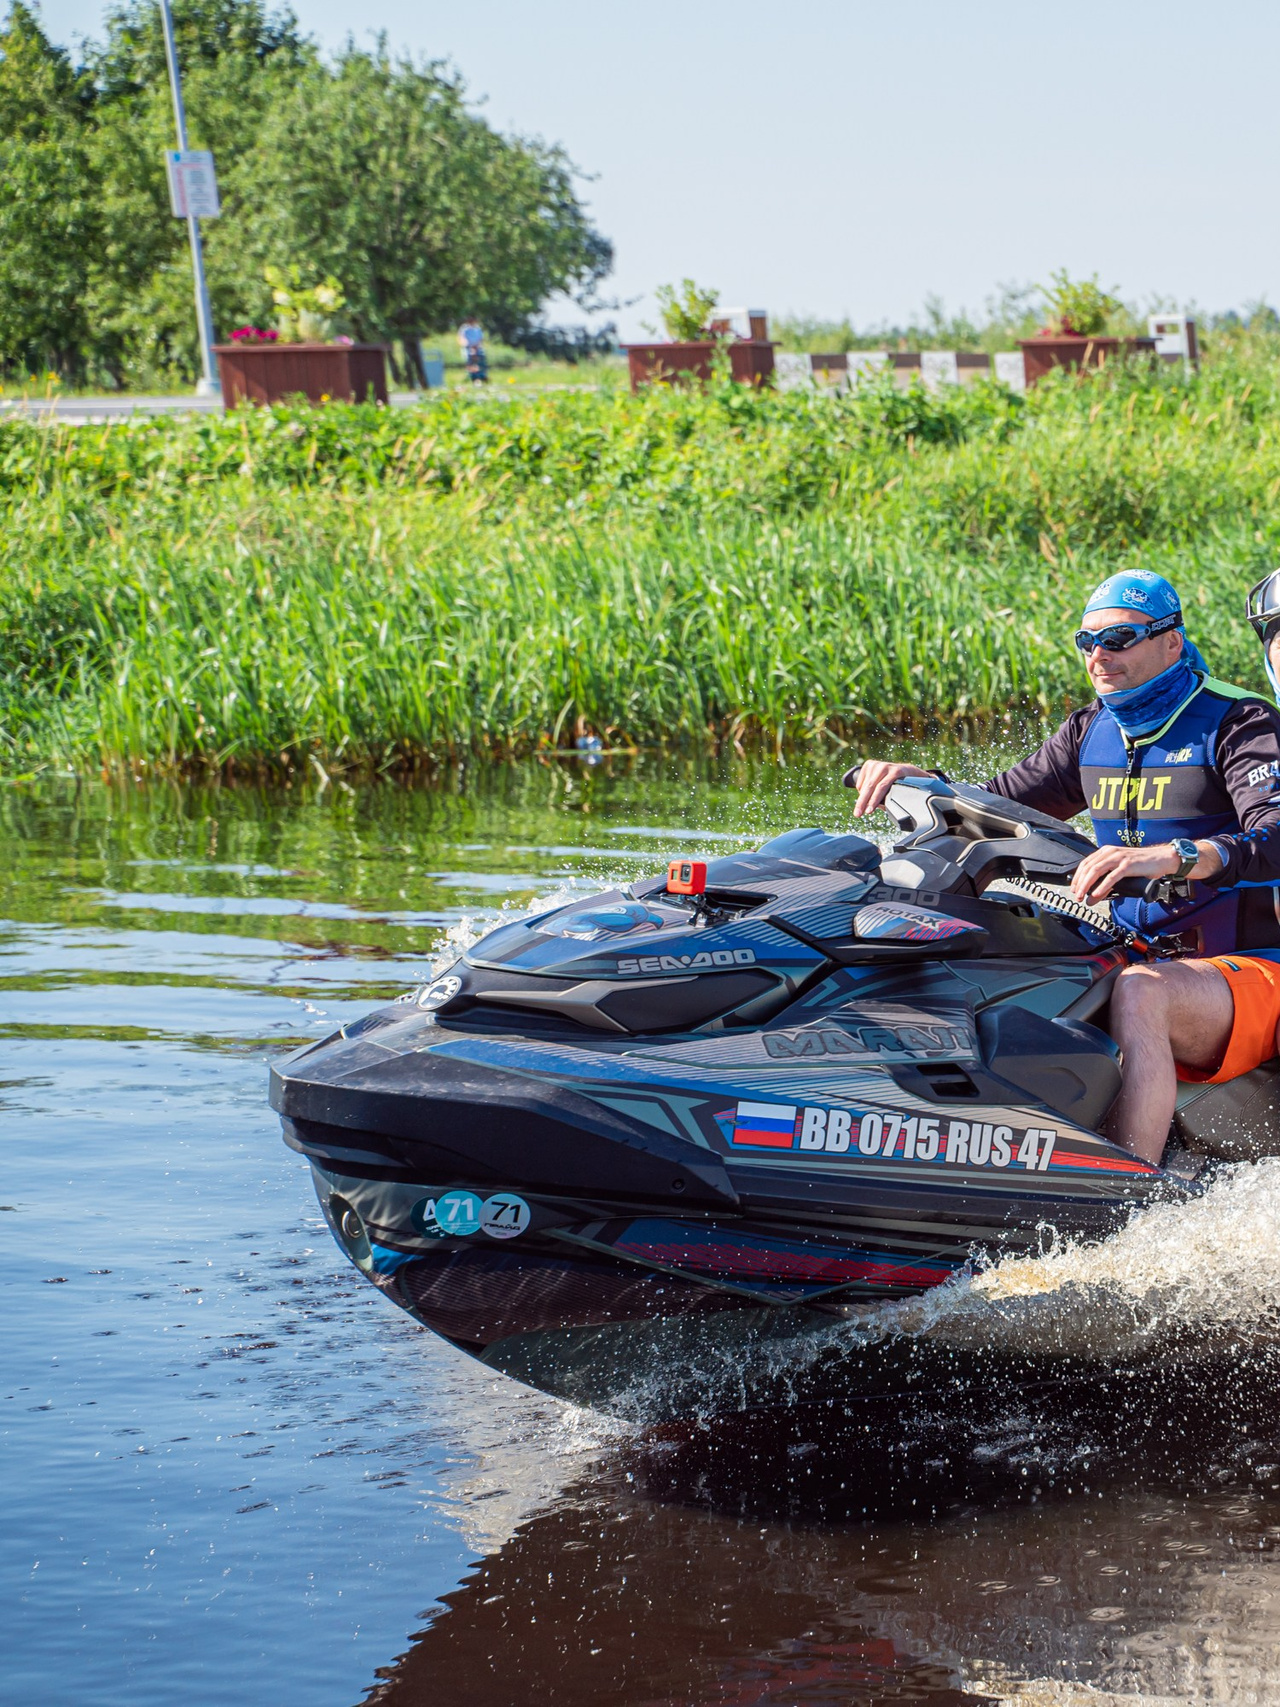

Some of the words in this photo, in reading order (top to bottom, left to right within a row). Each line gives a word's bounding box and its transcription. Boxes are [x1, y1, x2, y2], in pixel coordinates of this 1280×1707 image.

[1092, 776, 1172, 811] JTPLT
[867, 887, 941, 906] 300
[875, 905, 941, 929] ROTAX
[857, 1112, 941, 1161] 0715
[944, 1119, 1014, 1168] RUS
[1016, 1127, 1057, 1171] 47
[444, 1198, 475, 1222] 71
[491, 1201, 521, 1223] 71
